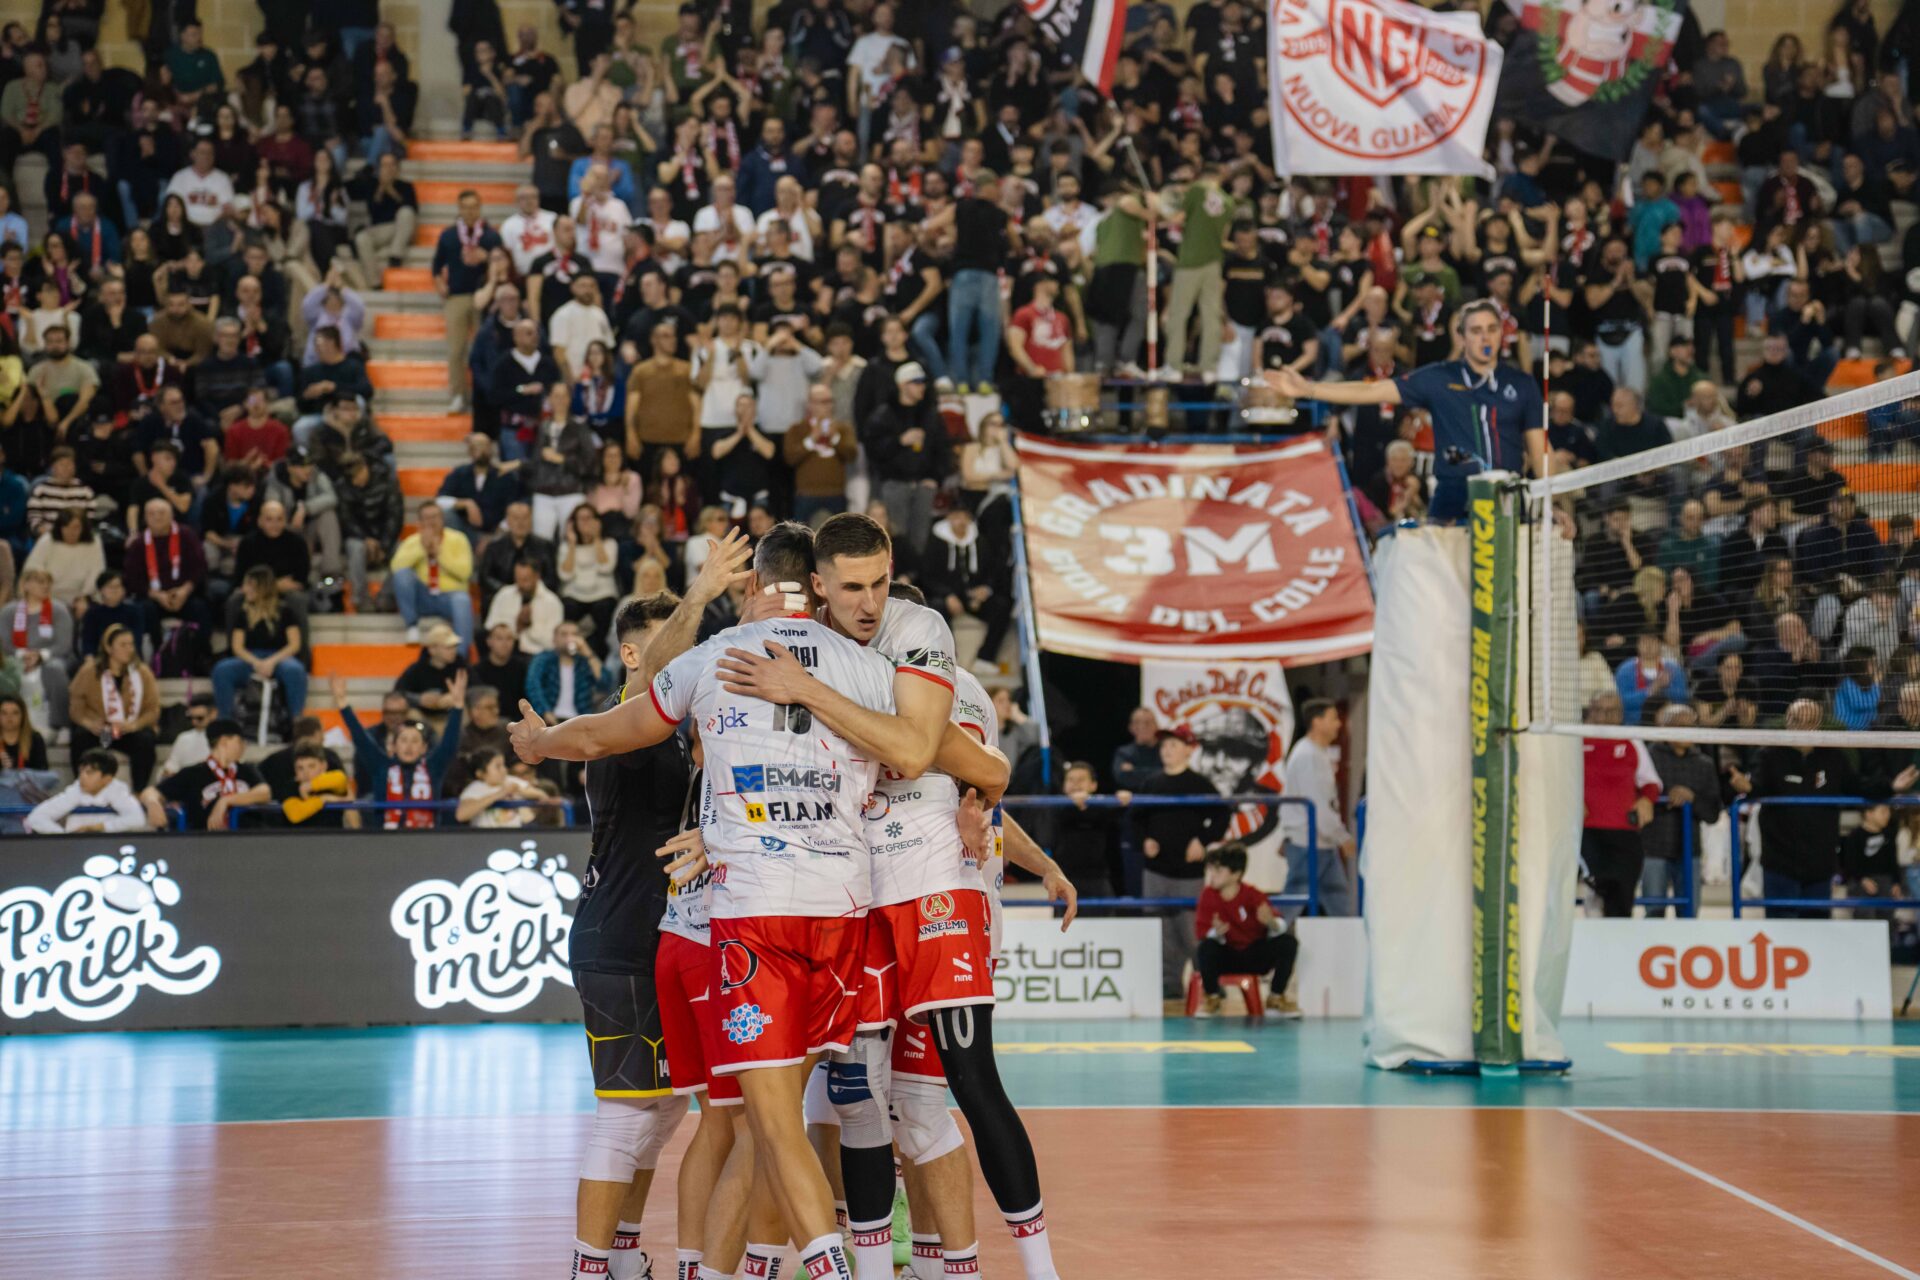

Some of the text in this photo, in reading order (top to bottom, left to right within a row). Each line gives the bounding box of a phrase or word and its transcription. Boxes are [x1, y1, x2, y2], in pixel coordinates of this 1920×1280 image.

[1285, 74, 1361, 147] NUOVA
[1040, 474, 1332, 537] GRADINATA
[1098, 521, 1281, 577] 3M
[1472, 499, 1495, 615] BANCA
[1149, 605, 1242, 633] DEL
[1250, 546, 1345, 623] COLLE
[1472, 626, 1493, 756] CREDEM
[716, 707, 749, 735] jdk
[766, 767, 842, 793] EMMEGI
[889, 788, 922, 804] zero
[870, 844, 885, 855] DE
[885, 837, 924, 852] GRECIS
[14, 919, 207, 1008] milk
[953, 974, 974, 982] nine
[1638, 932, 1810, 990] GOUP
[1661, 998, 1791, 1010] NOLEGGI
[935, 1006, 975, 1050] 10
[903, 1051, 925, 1060] nine
[612, 1238, 633, 1248] JOY
[583, 1262, 606, 1272] JOY
